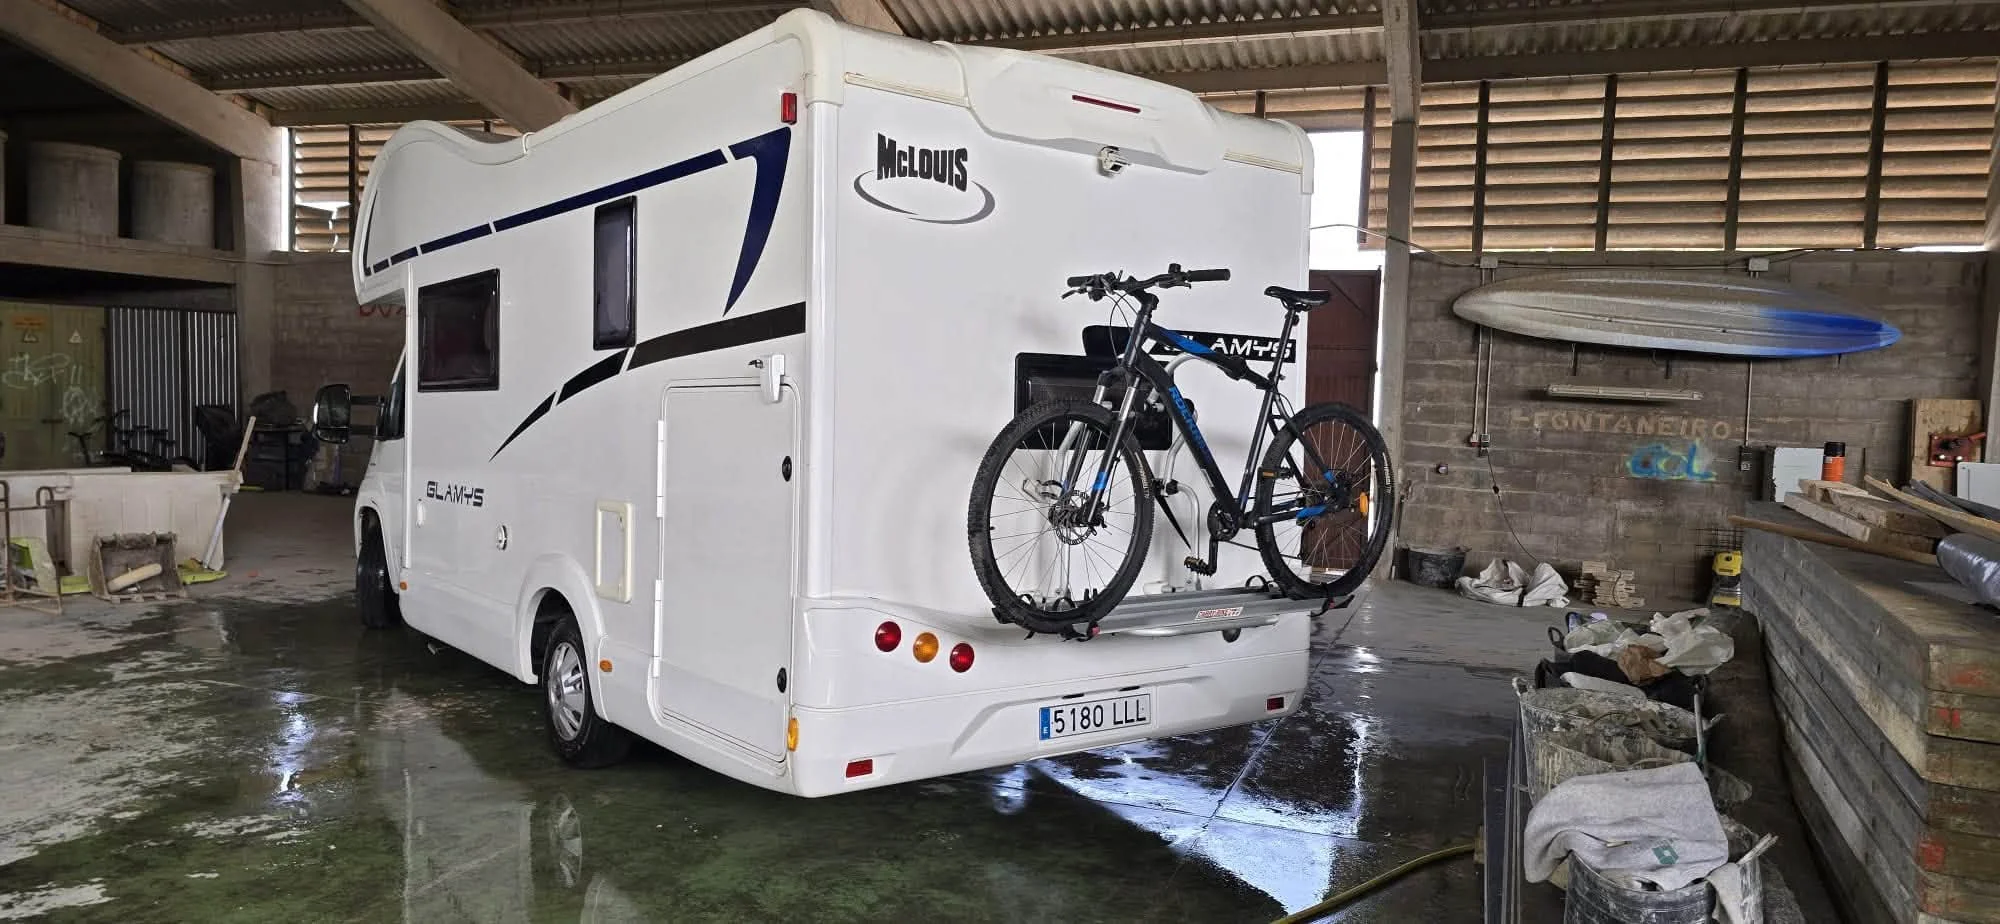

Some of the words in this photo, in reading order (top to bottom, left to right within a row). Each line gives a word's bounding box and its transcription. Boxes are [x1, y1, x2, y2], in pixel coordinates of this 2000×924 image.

[877, 132, 968, 192] McLOUIS
[1164, 335, 1292, 360] AMYS
[426, 480, 485, 508] GLAMYS
[1053, 704, 1104, 733] 5180
[1113, 699, 1147, 726] LLL
